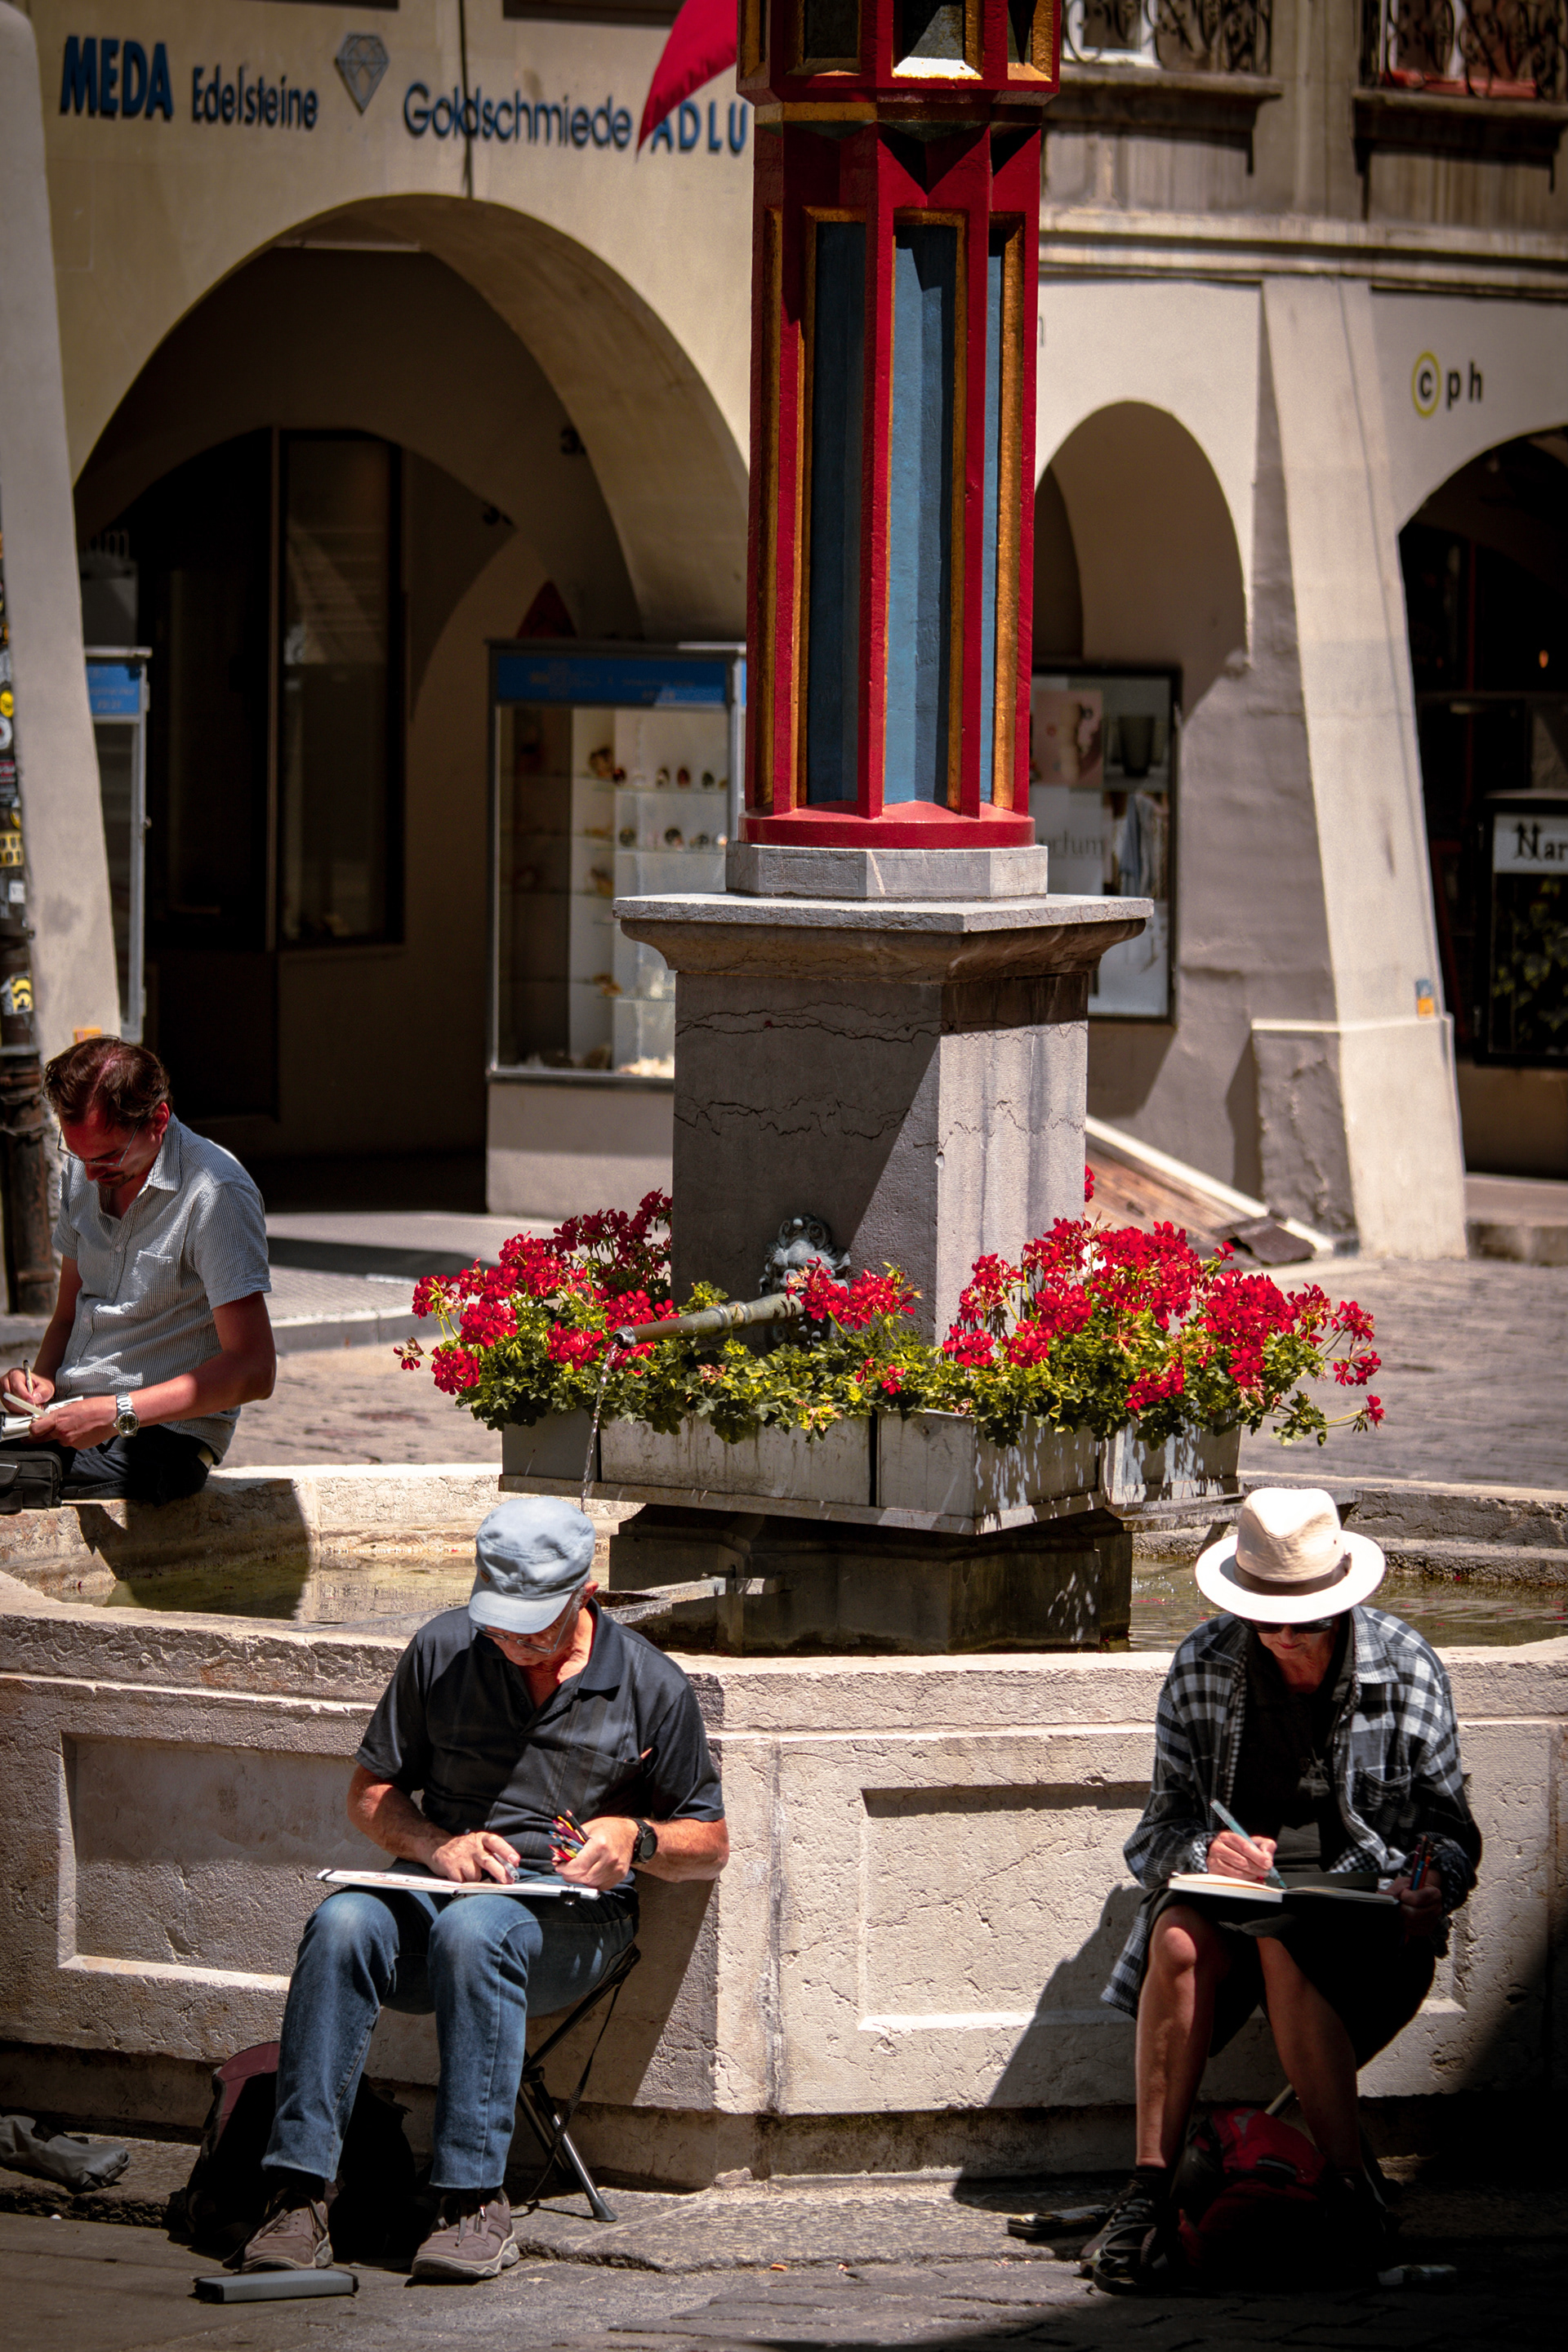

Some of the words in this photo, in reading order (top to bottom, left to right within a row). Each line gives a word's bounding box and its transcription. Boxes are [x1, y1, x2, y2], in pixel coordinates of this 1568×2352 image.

[60, 35, 174, 123] MEDA
[191, 64, 319, 131] Edelsteine
[403, 82, 632, 153] Goldschmiede
